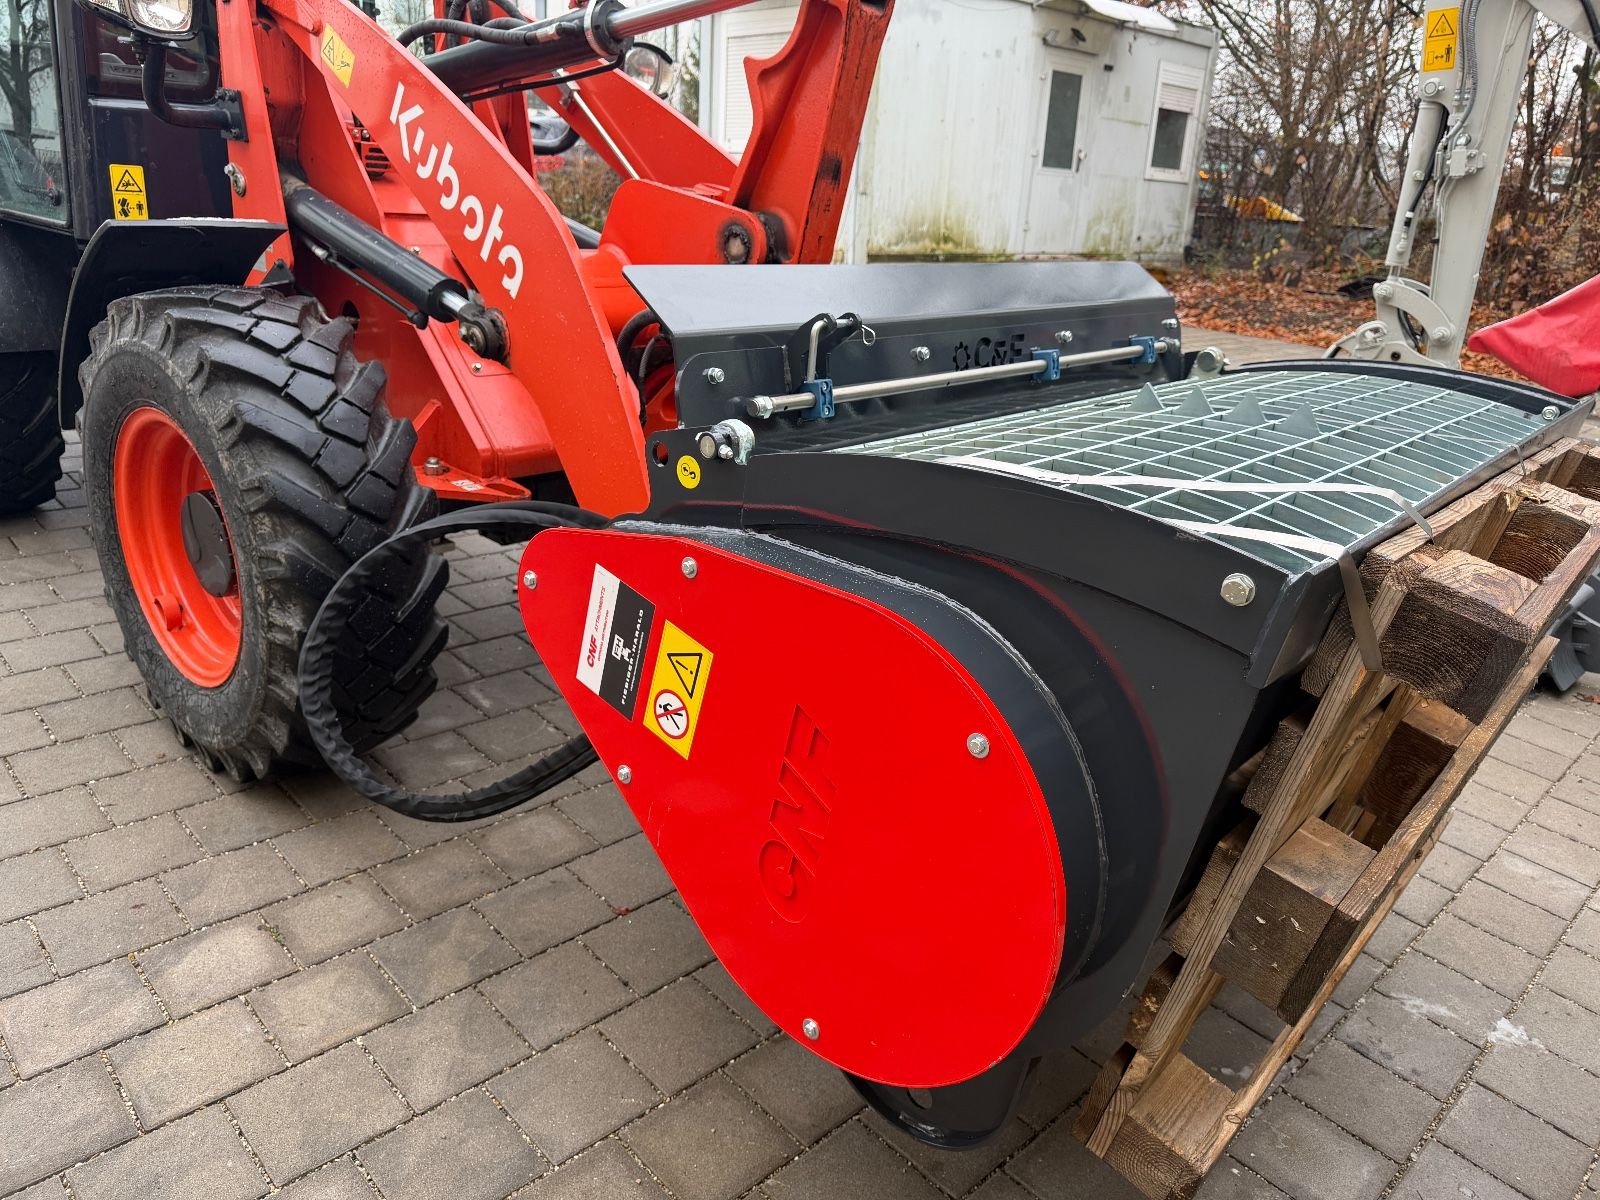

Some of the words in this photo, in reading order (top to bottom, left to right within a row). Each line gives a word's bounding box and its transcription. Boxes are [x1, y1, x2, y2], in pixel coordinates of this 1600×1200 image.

[389, 81, 524, 299] Kubota
[587, 634, 599, 668] CNF
[758, 703, 838, 924] CNF
